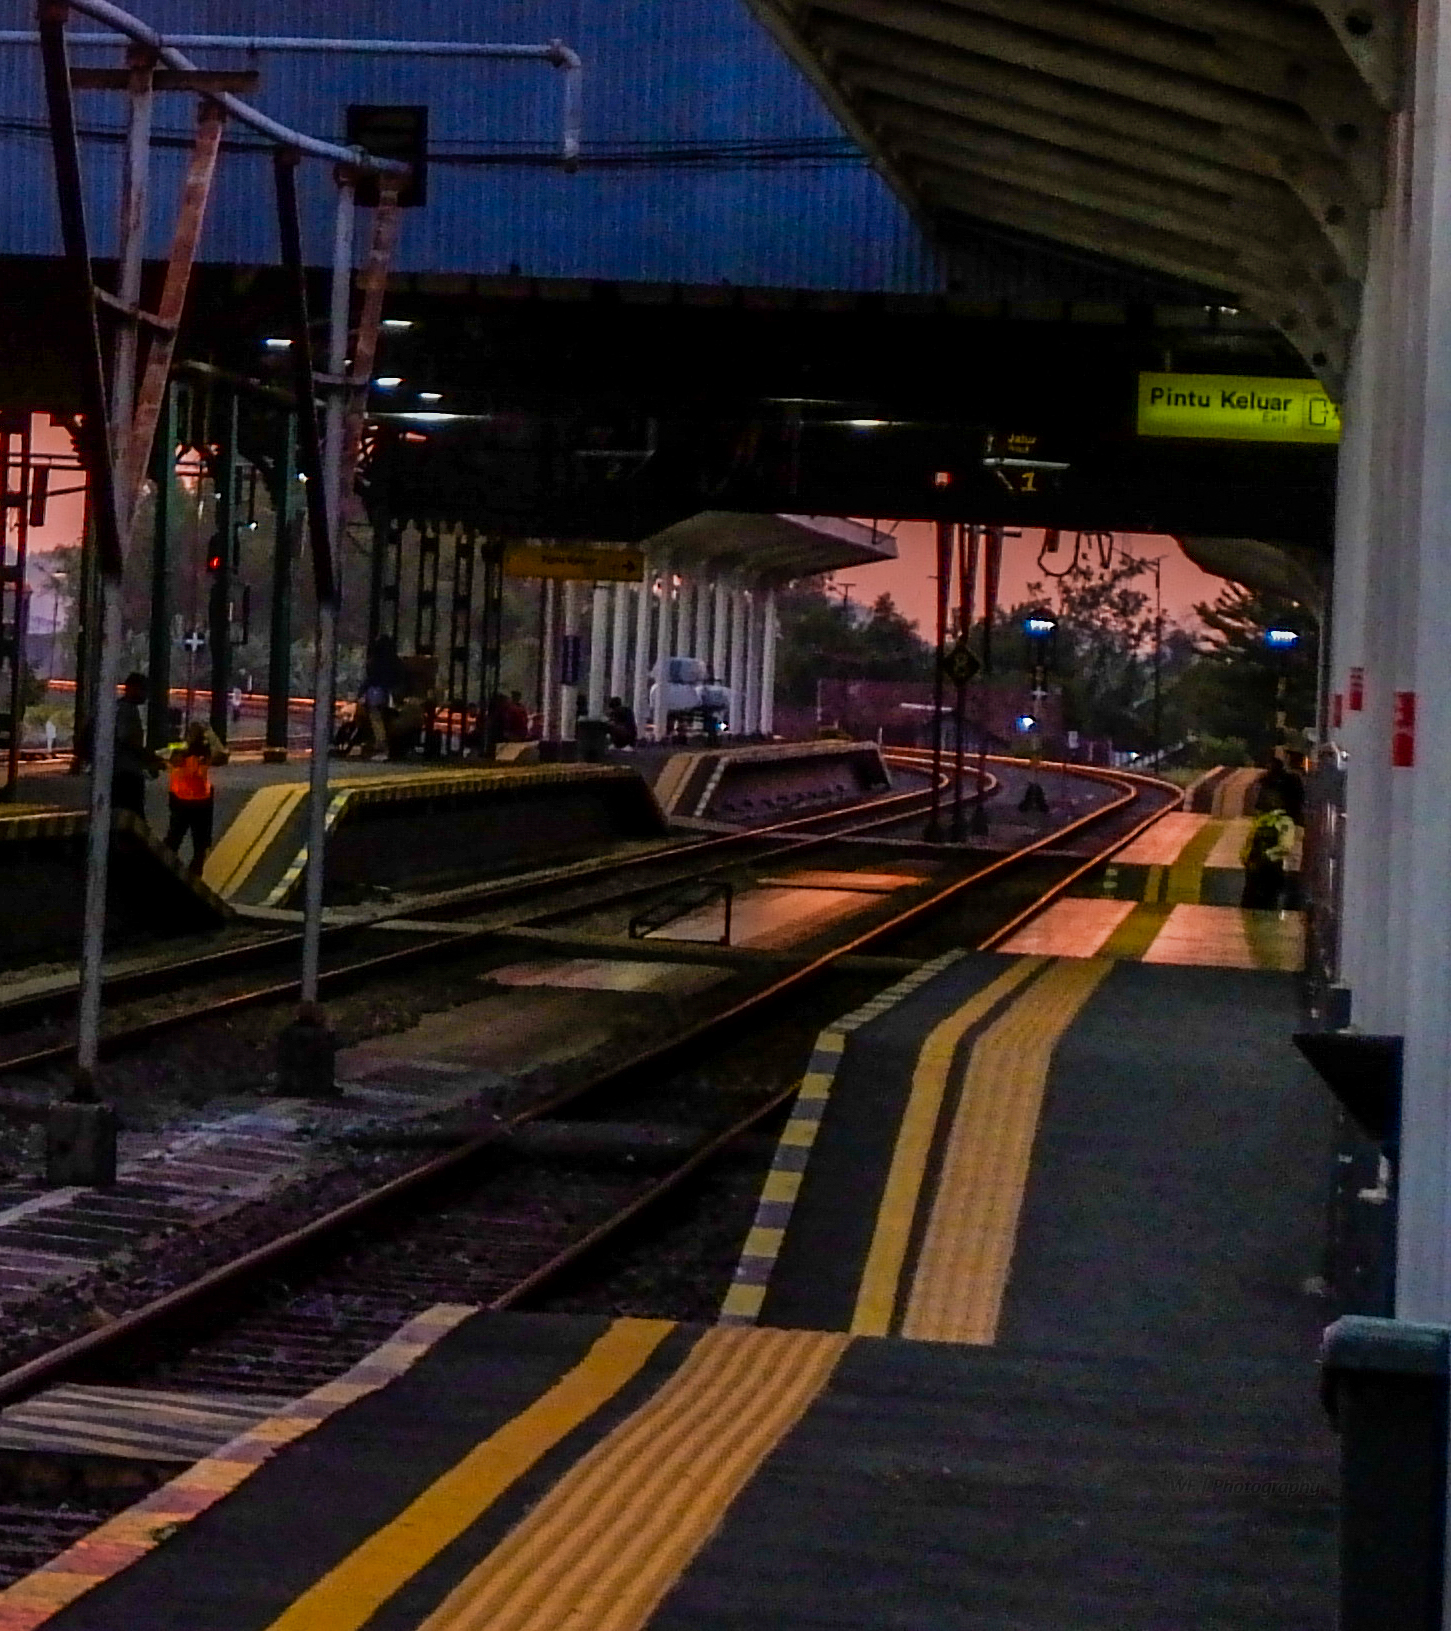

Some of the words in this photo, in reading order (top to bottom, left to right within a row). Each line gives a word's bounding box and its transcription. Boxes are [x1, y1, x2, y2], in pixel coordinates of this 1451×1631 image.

[1150, 387, 1211, 408] Pintu
[1221, 390, 1293, 412] Keluar
[1020, 472, 1037, 492] 1
